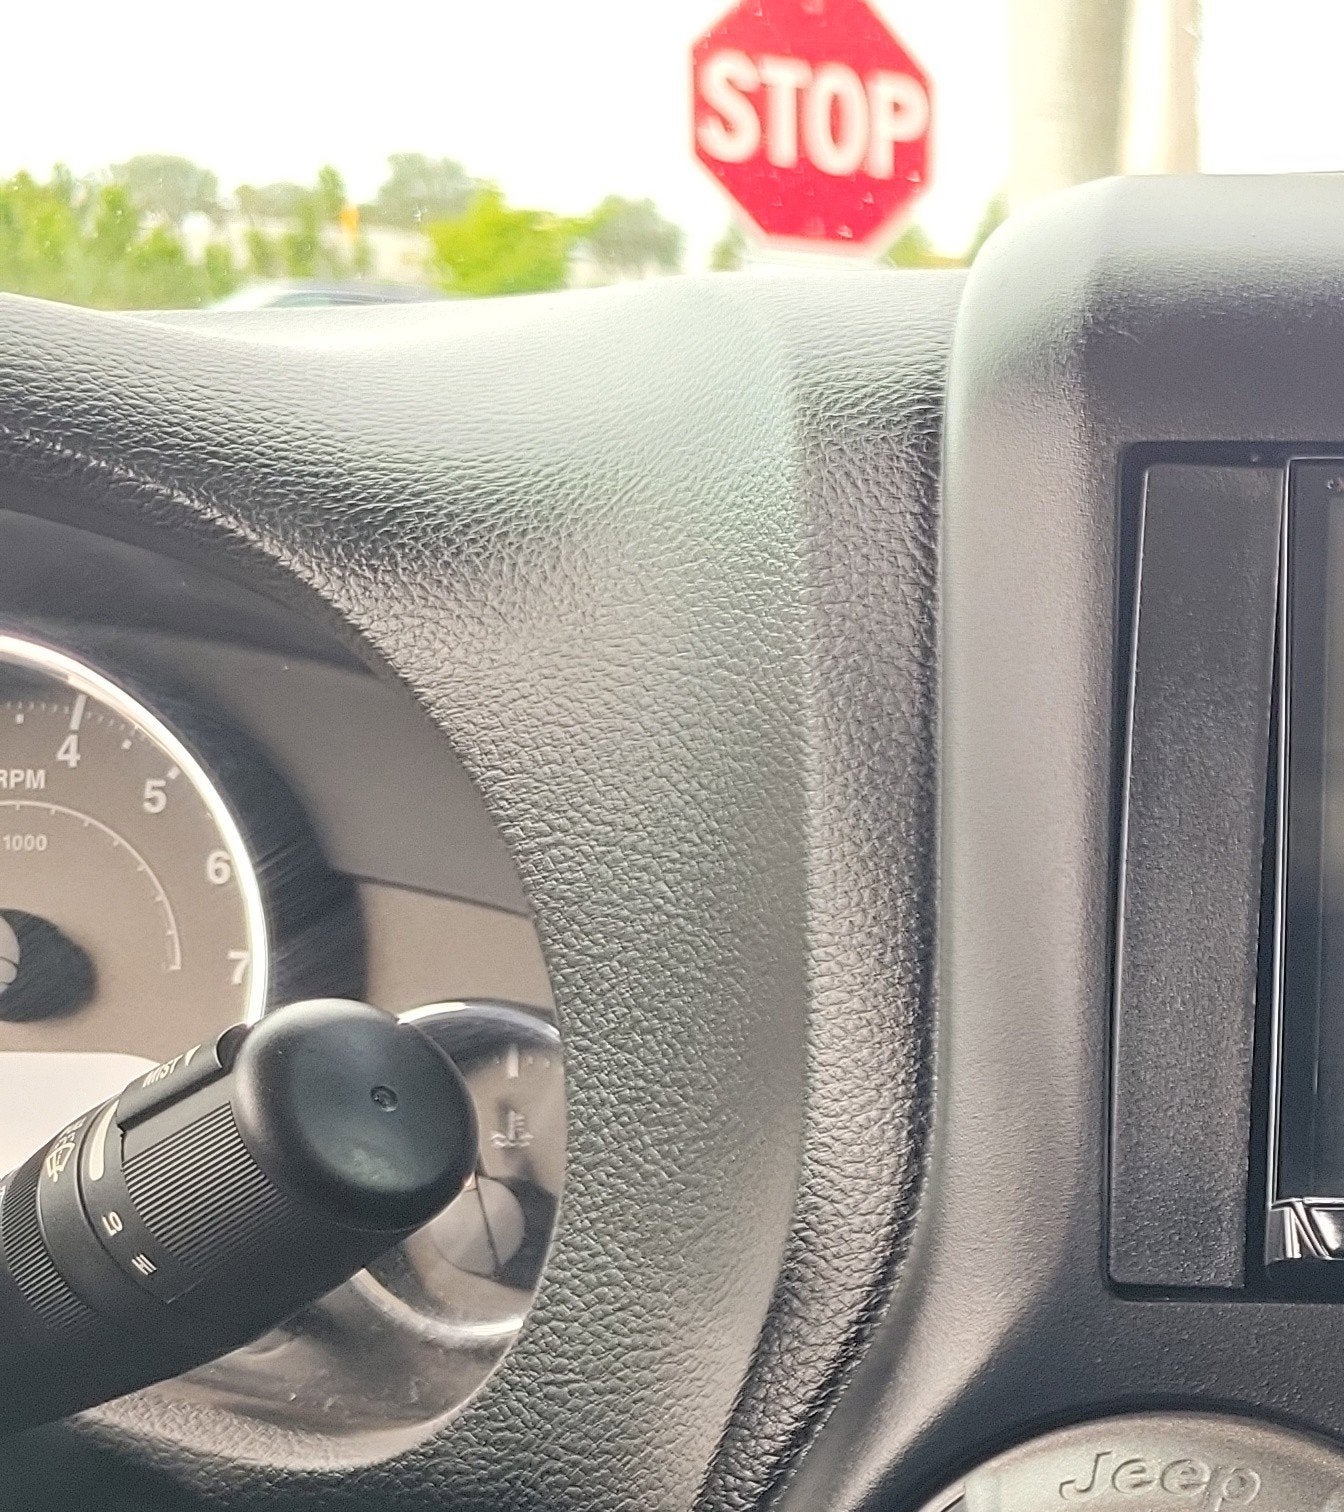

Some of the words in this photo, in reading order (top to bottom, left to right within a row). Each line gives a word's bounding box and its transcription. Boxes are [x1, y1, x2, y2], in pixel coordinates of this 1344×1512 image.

[697, 48, 930, 180] STOP
[56, 734, 81, 769] 4
[142, 779, 168, 814] 5
[3, 833, 48, 852] 1000
[206, 850, 231, 885] 6
[226, 950, 250, 986] 7
[142, 1053, 184, 1088] MIST
[102, 1211, 123, 1237] LO
[131, 1252, 158, 1276] HI
[1058, 1449, 1262, 1512] Jeep
